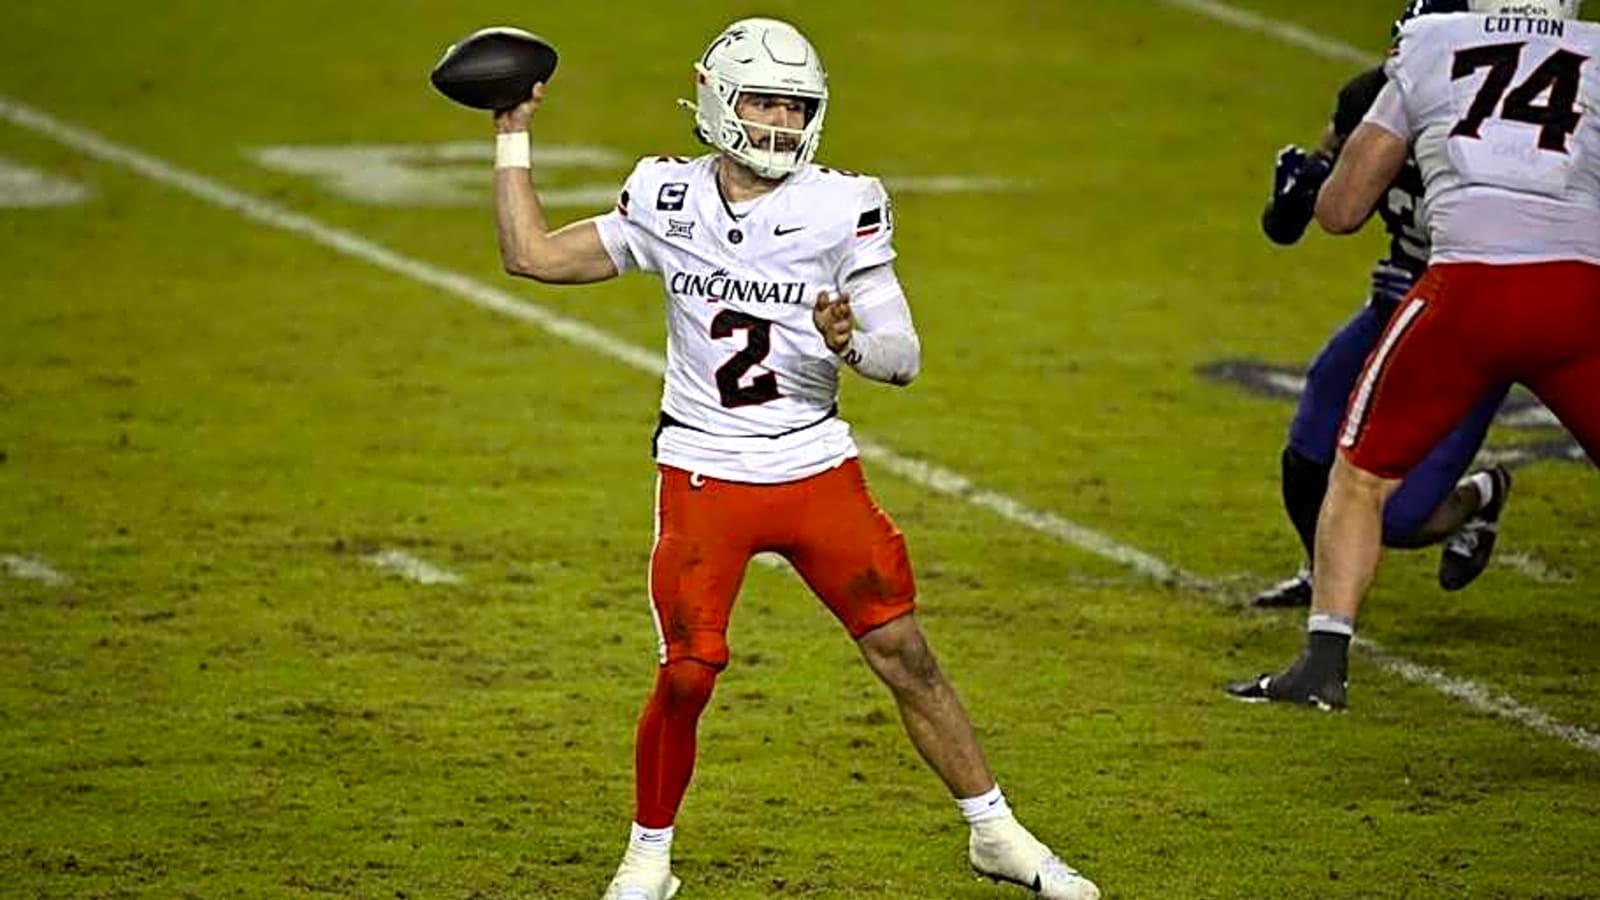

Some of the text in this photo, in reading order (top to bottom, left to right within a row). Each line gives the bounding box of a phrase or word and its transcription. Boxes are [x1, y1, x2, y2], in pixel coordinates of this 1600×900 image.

[1485, 16, 1564, 37] COTTON
[1449, 41, 1592, 154] 74
[671, 270, 806, 304] CINCINNATI
[710, 309, 784, 408] 2
